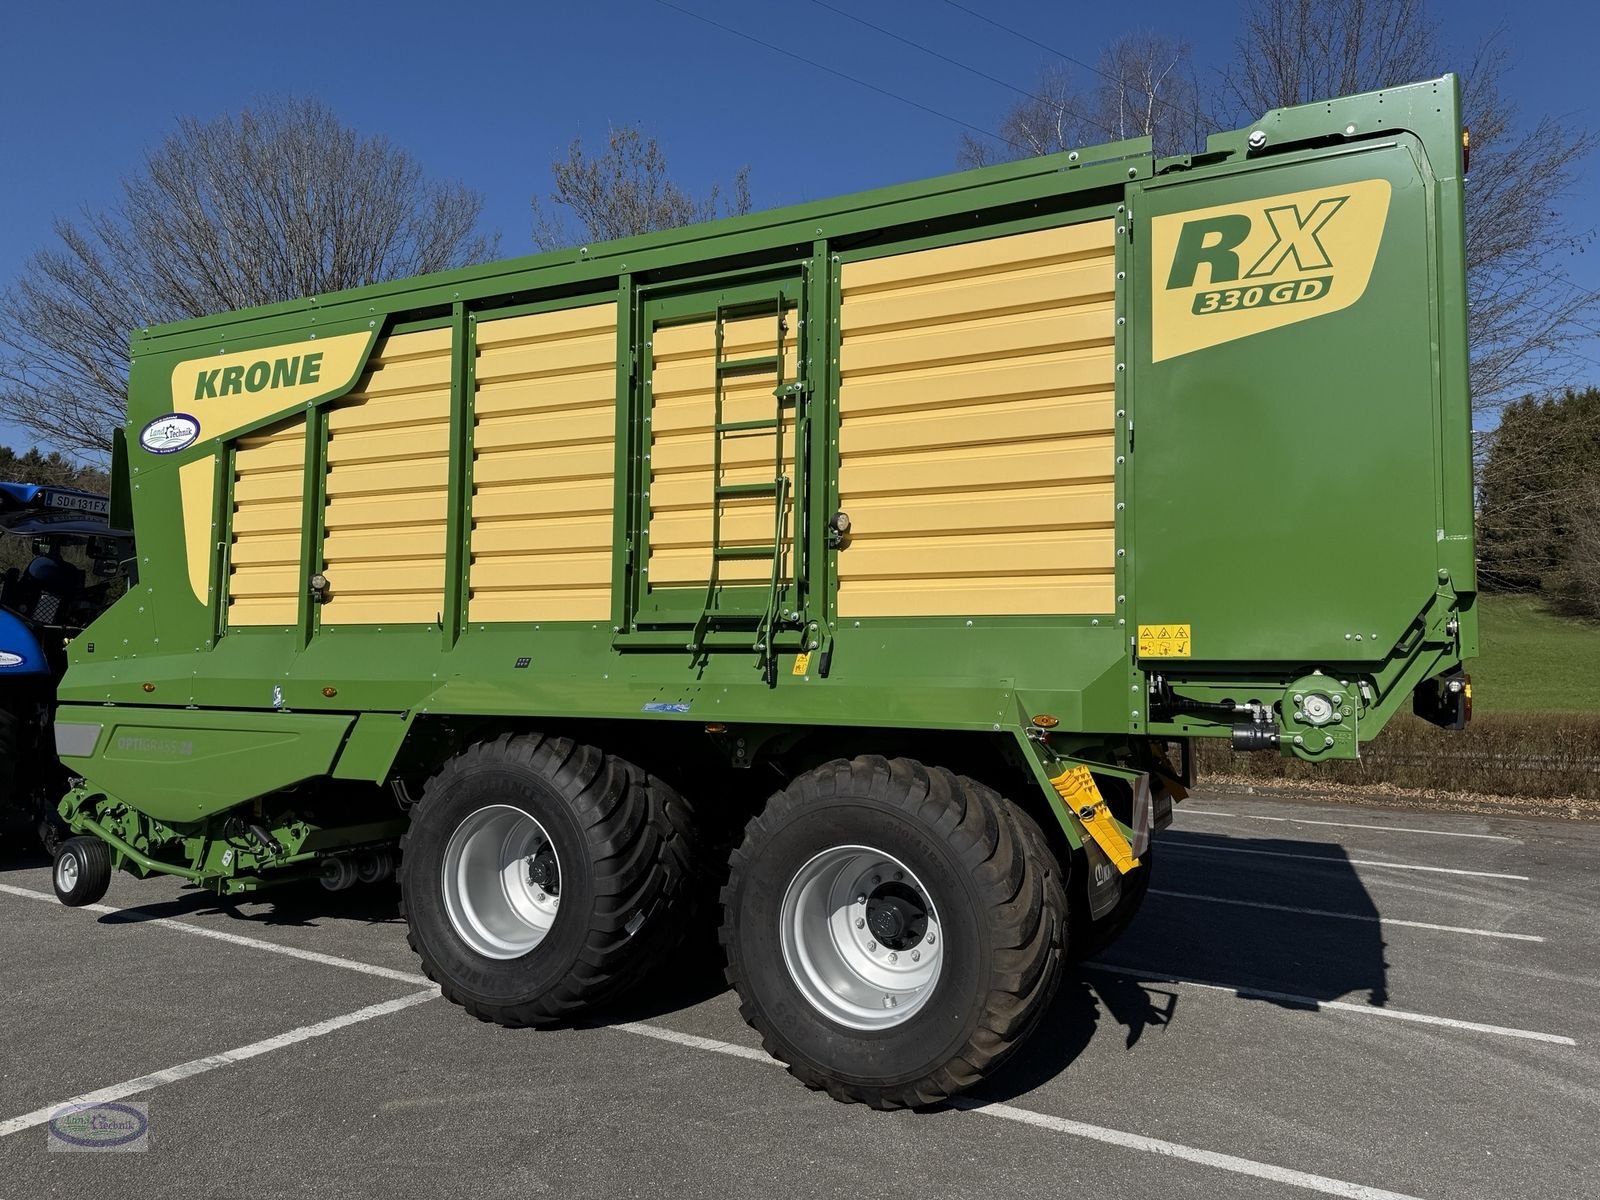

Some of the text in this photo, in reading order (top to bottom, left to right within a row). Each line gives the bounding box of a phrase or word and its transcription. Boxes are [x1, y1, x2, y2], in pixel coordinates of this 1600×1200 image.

[1165, 195, 1351, 290] RX
[1199, 280, 1323, 313] 330 GD
[194, 352, 324, 400] KRONE
[56, 495, 70, 507] SD
